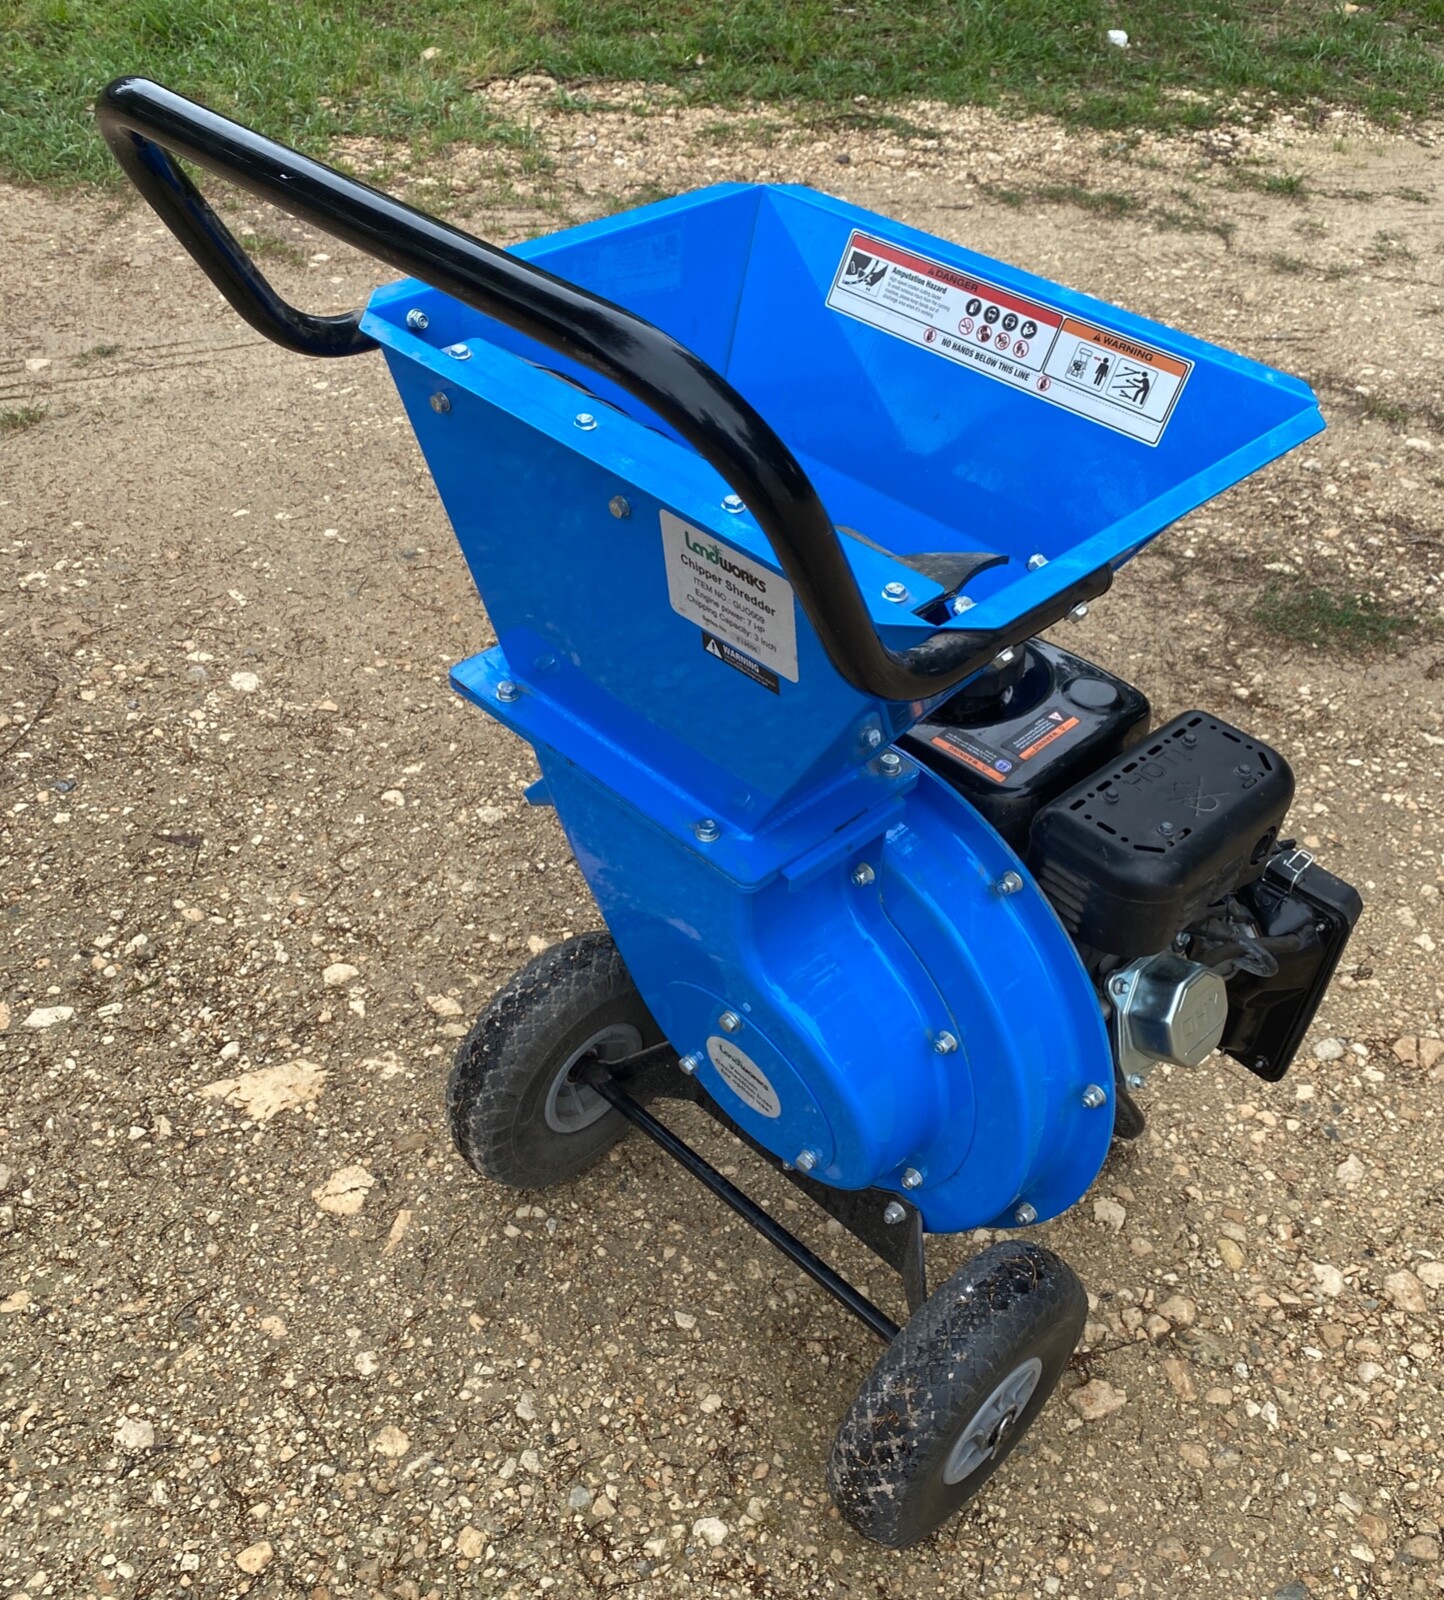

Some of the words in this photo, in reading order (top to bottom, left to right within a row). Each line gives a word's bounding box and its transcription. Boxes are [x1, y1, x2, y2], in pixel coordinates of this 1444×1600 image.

[892, 266, 925, 285] Amputation
[925, 280, 947, 294] Hazard
[936, 269, 978, 292] DANGER
[941, 338, 951, 348] NO
[952, 342, 973, 357] HANDS
[974, 351, 1000, 367] BELOW
[998, 360, 1014, 374] THIS
[1014, 367, 1030, 381] LINE
[1103, 335, 1153, 362] WARNING
[681, 554, 722, 584] Chipper
[725, 581, 776, 615] Shredder
[694, 577, 712, 592] ITEM
[686, 594, 717, 617] Chipping
[695, 588, 719, 608] Engine
[754, 622, 765, 634] HP
[723, 644, 760, 673] WARNING
[948, 745, 978, 766] WARNING
